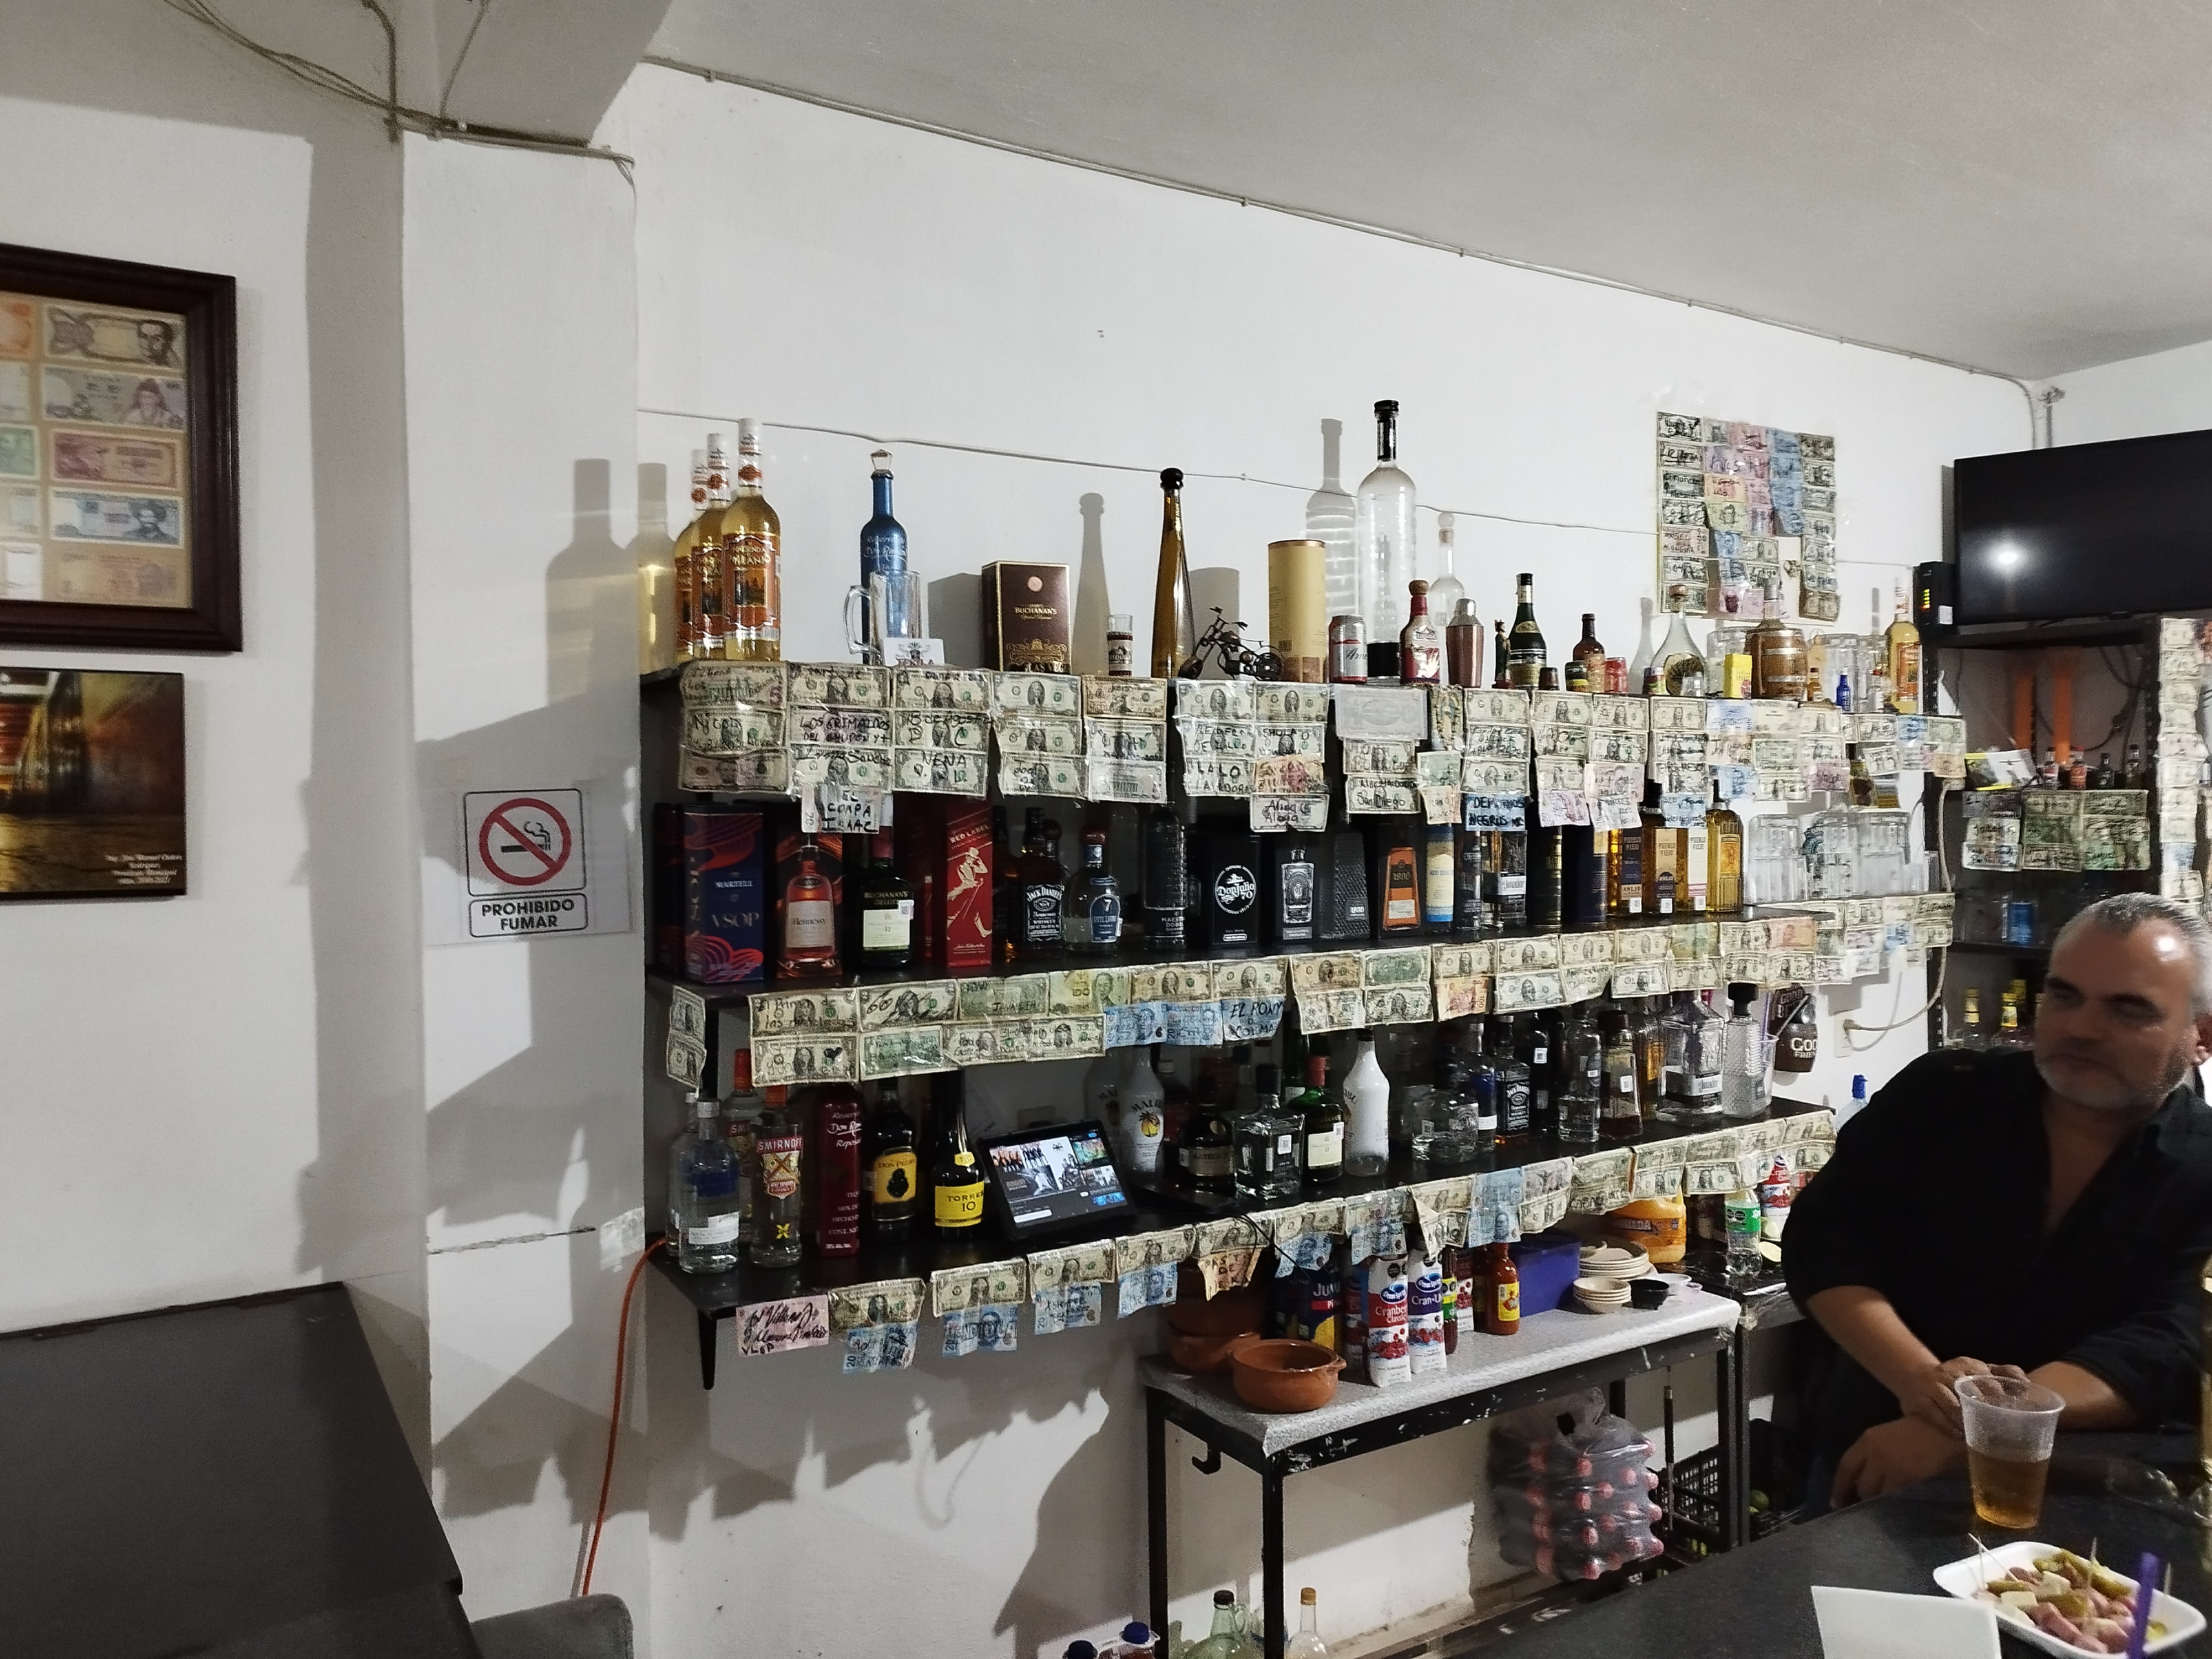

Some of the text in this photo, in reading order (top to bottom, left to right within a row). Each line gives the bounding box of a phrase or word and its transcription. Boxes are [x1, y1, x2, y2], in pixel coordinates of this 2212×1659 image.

[1015, 607, 1057, 615] BUCHANAN'S
[1048, 661, 1070, 673] VEG
[950, 833, 966, 844] RED
[967, 824, 989, 837] LABEL
[864, 890, 909, 899] BUCHANAN'S
[1026, 887, 1041, 902] JACK
[482, 899, 575, 917] PROHIBIDO
[1104, 899, 1112, 912] 7
[500, 915, 558, 931] FUMAR
[794, 917, 826, 926] Hennessy
[947, 1190, 984, 1202] TORRES
[962, 1201, 976, 1212] 10
